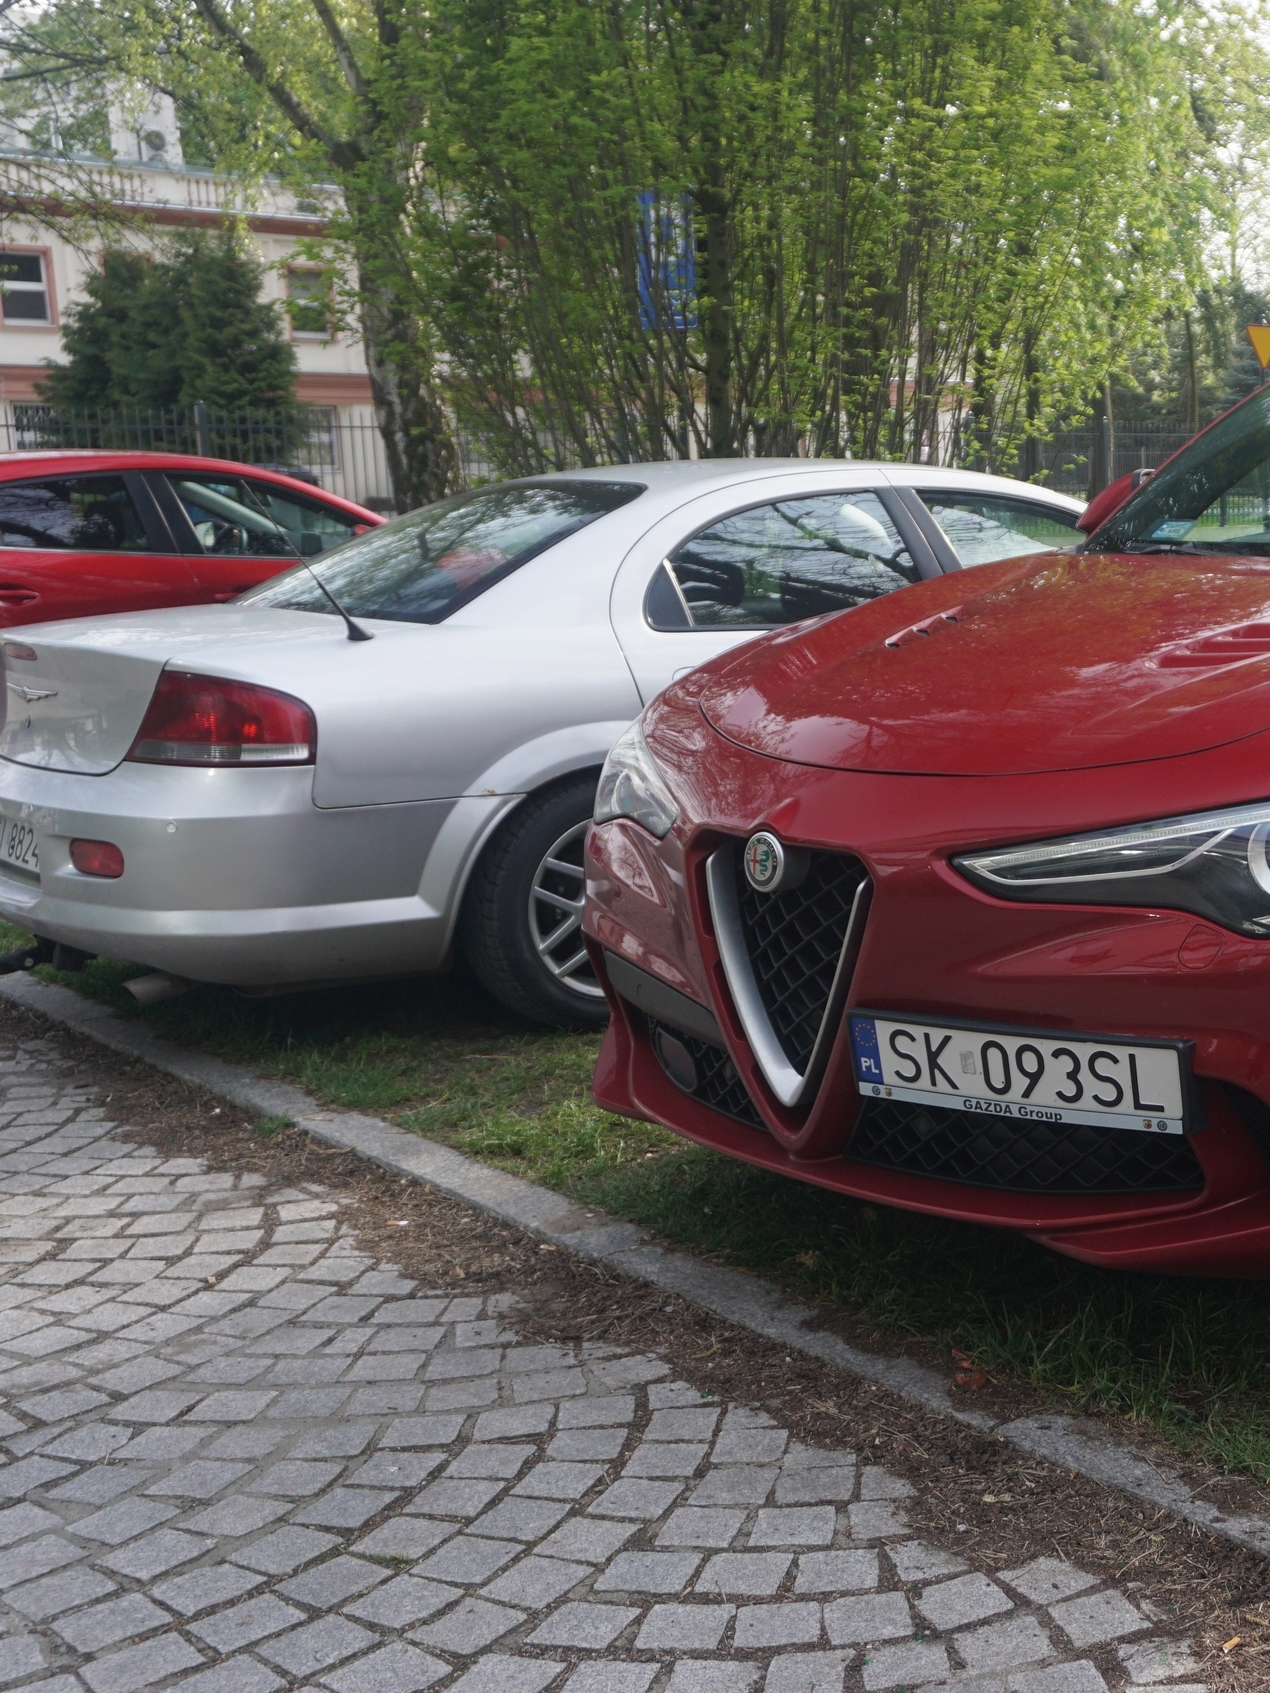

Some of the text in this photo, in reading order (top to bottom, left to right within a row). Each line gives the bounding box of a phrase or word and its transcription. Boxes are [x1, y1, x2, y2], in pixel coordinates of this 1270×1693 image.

[861, 1058, 879, 1074] PL
[889, 1028, 1165, 1113] SK 093SL
[963, 1099, 1063, 1123] GAZDA Group
